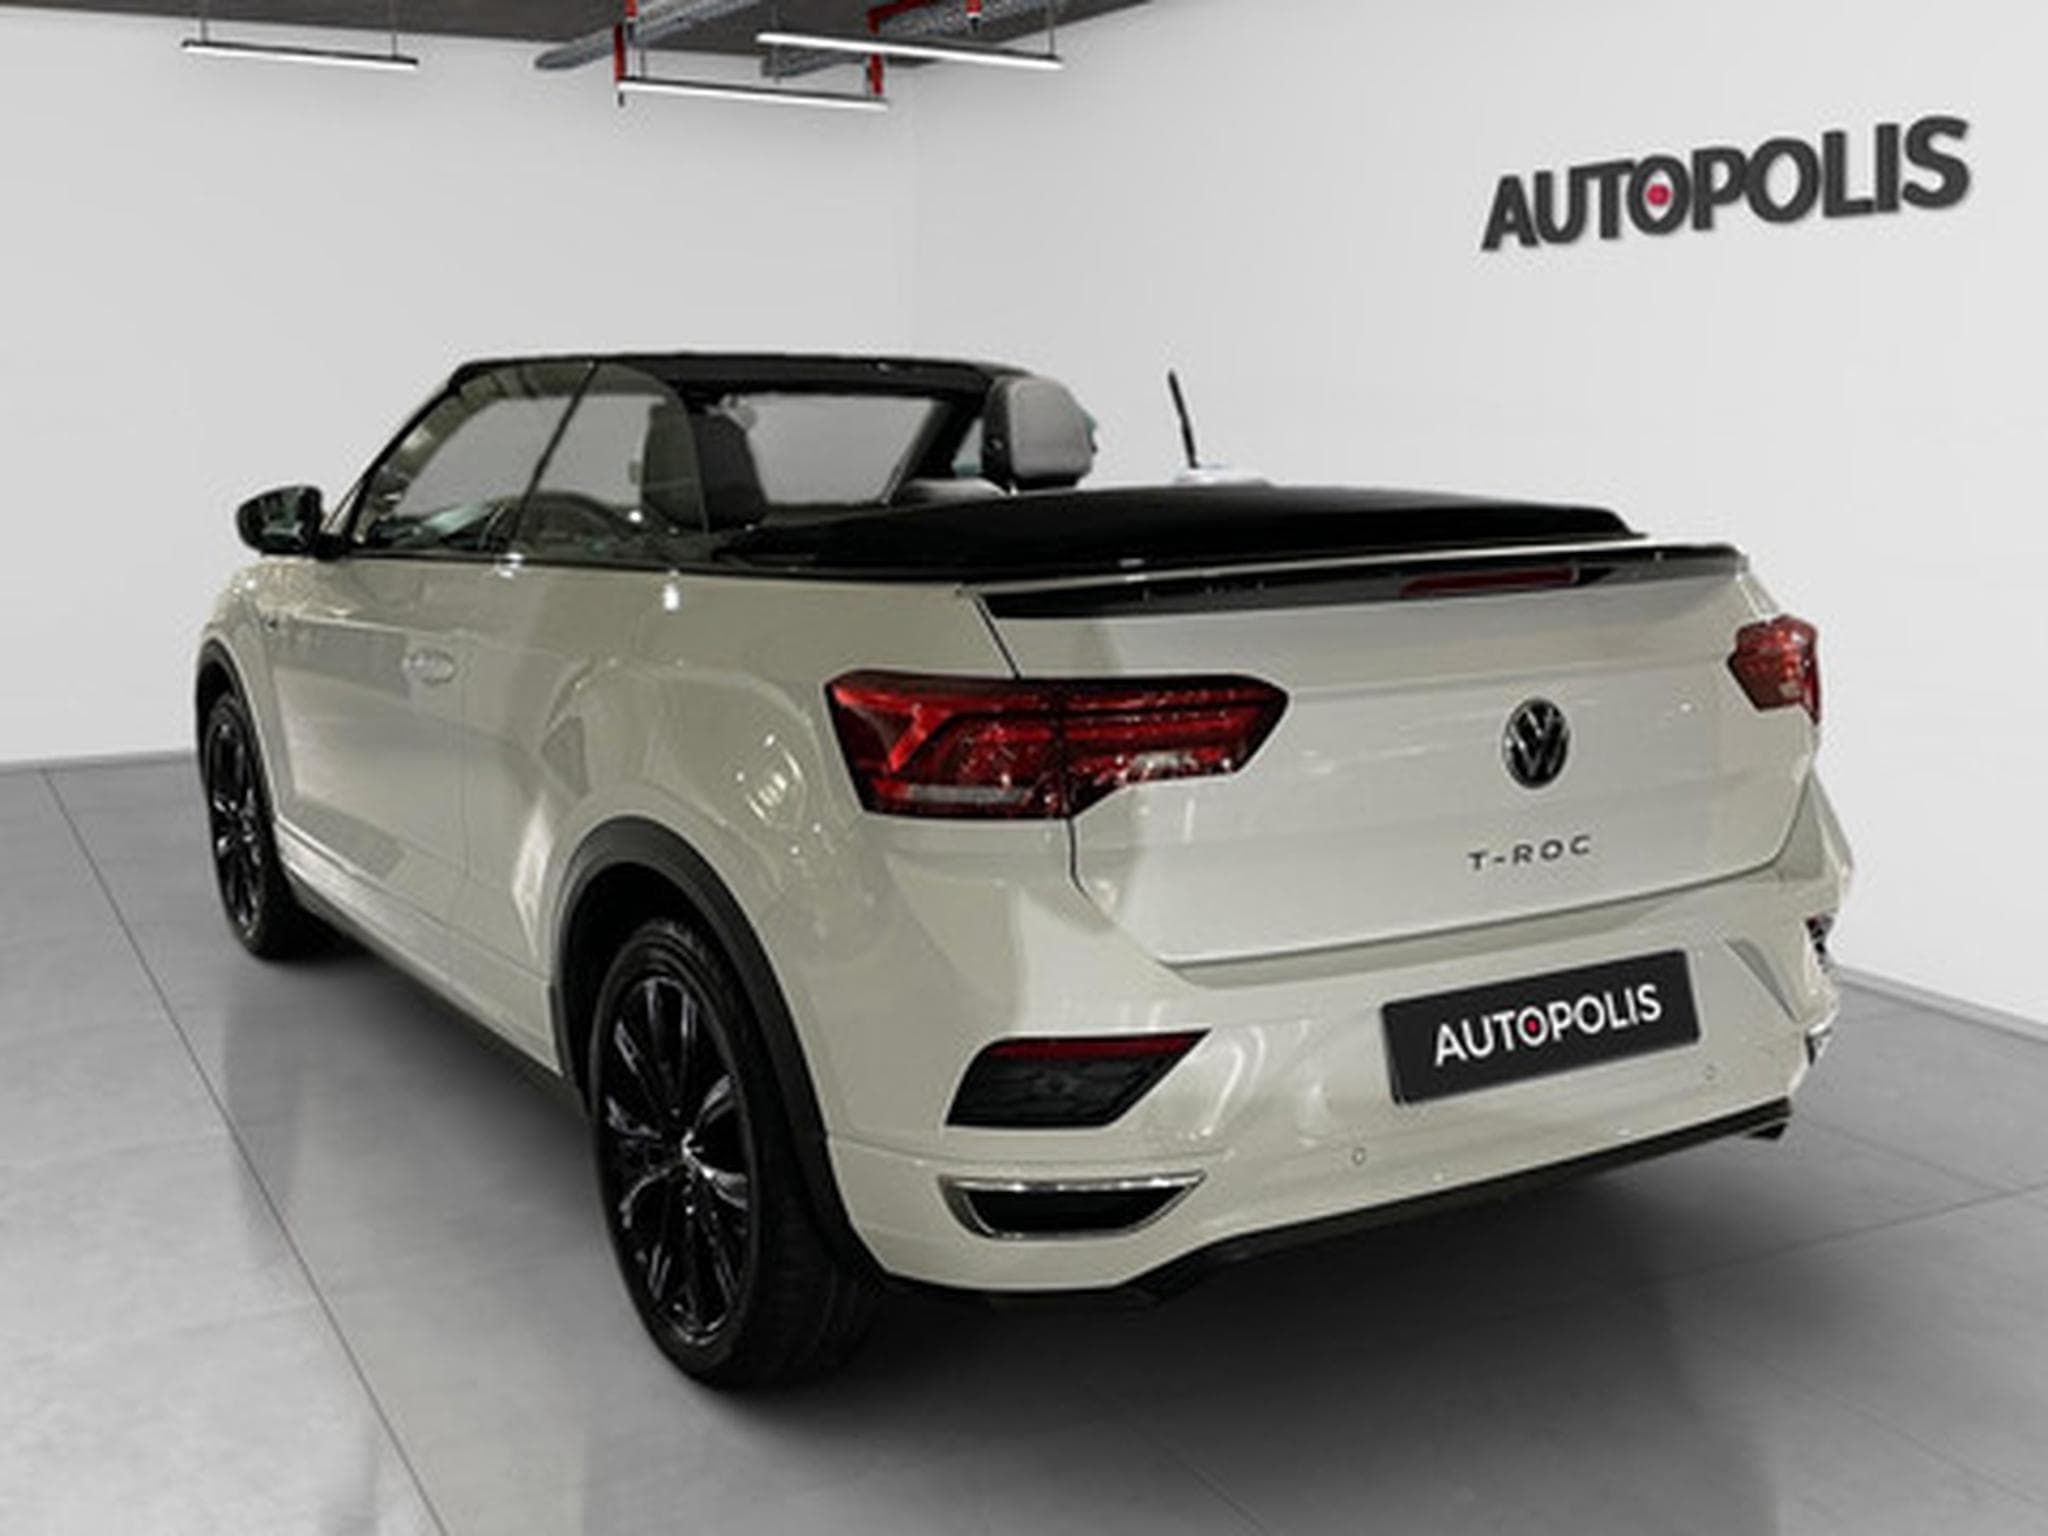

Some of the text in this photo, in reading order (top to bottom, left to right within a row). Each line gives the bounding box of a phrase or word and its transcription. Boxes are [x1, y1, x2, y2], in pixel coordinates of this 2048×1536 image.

[1481, 115, 1970, 252] AUTOPOLIS
[1468, 835, 1593, 870] T-ROC
[1434, 983, 1662, 1067] AUTOPOLIS
